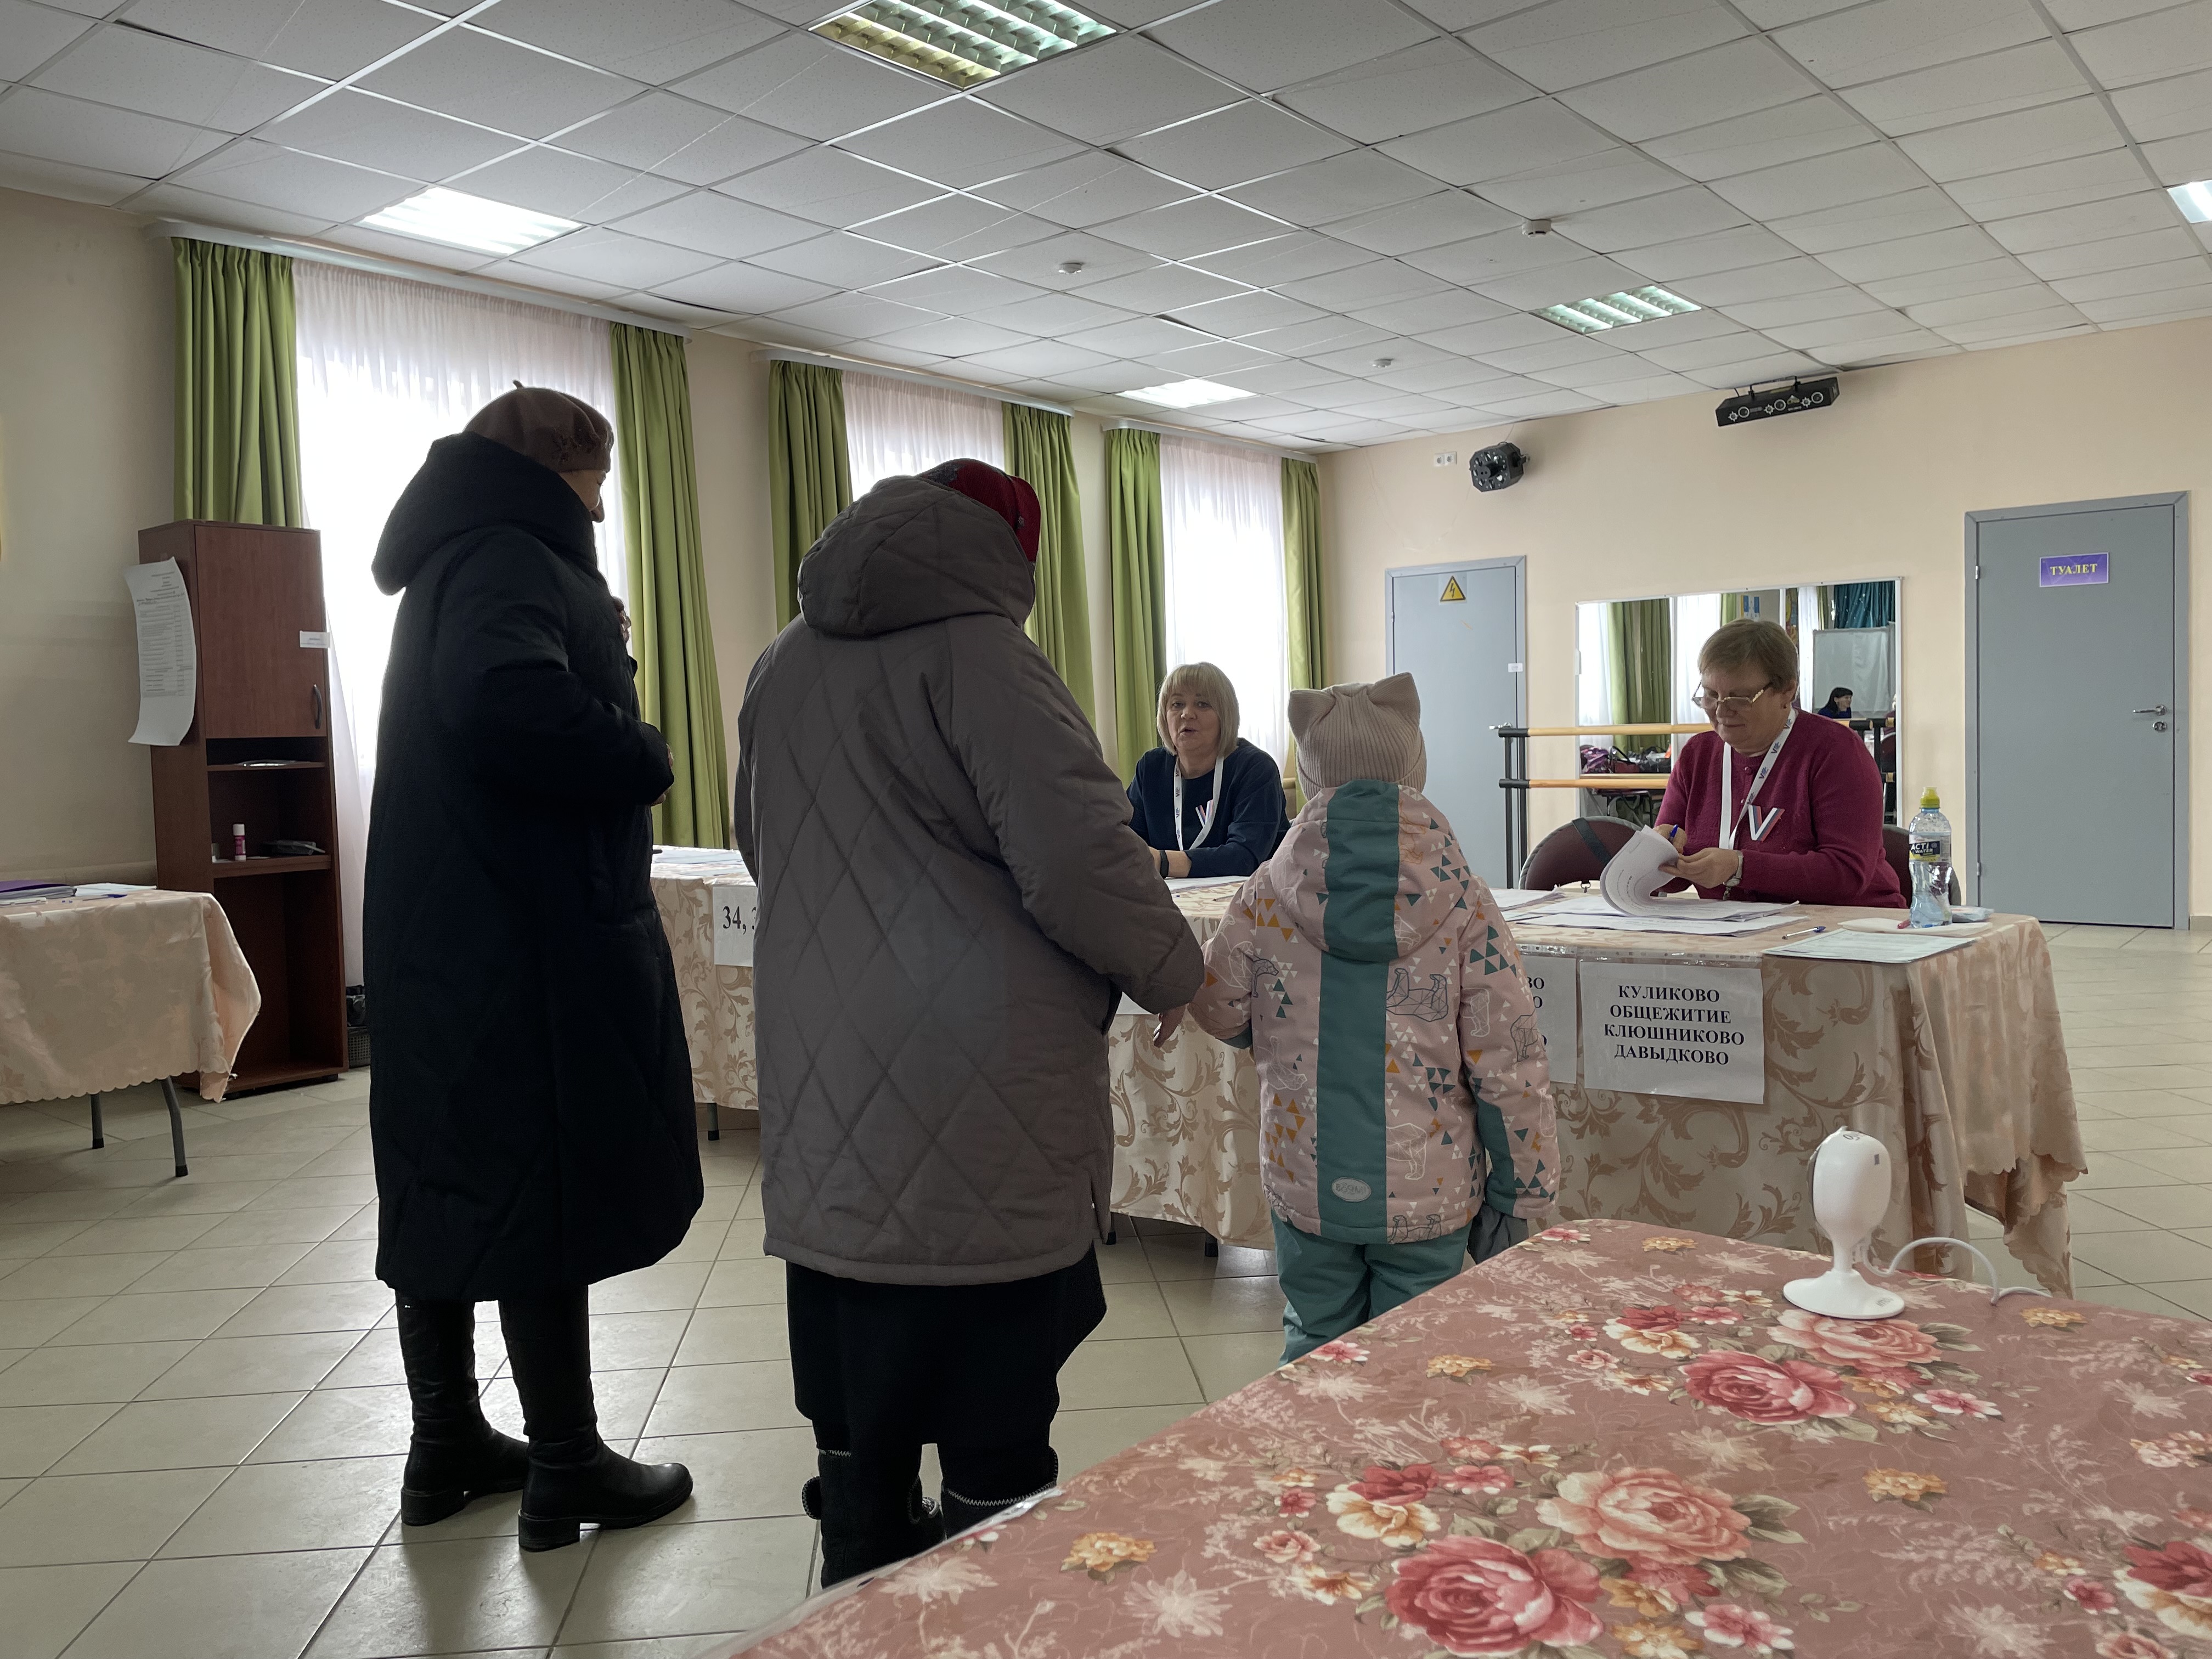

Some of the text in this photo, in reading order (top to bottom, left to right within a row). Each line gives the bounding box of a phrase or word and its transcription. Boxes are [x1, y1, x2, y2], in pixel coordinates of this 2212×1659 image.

[2050, 563, 2098, 575] ТУАЛЕТ
[1911, 842, 1929, 850] ACTI
[1618, 985, 1720, 1003] КУЛИКОВО
[1610, 1005, 1731, 1024] ОБЩЕЖИТИЕ
[1604, 1024, 1745, 1046] КЛЮШНИКОВО
[1614, 1044, 1729, 1065] ДАВЫДКОВО
